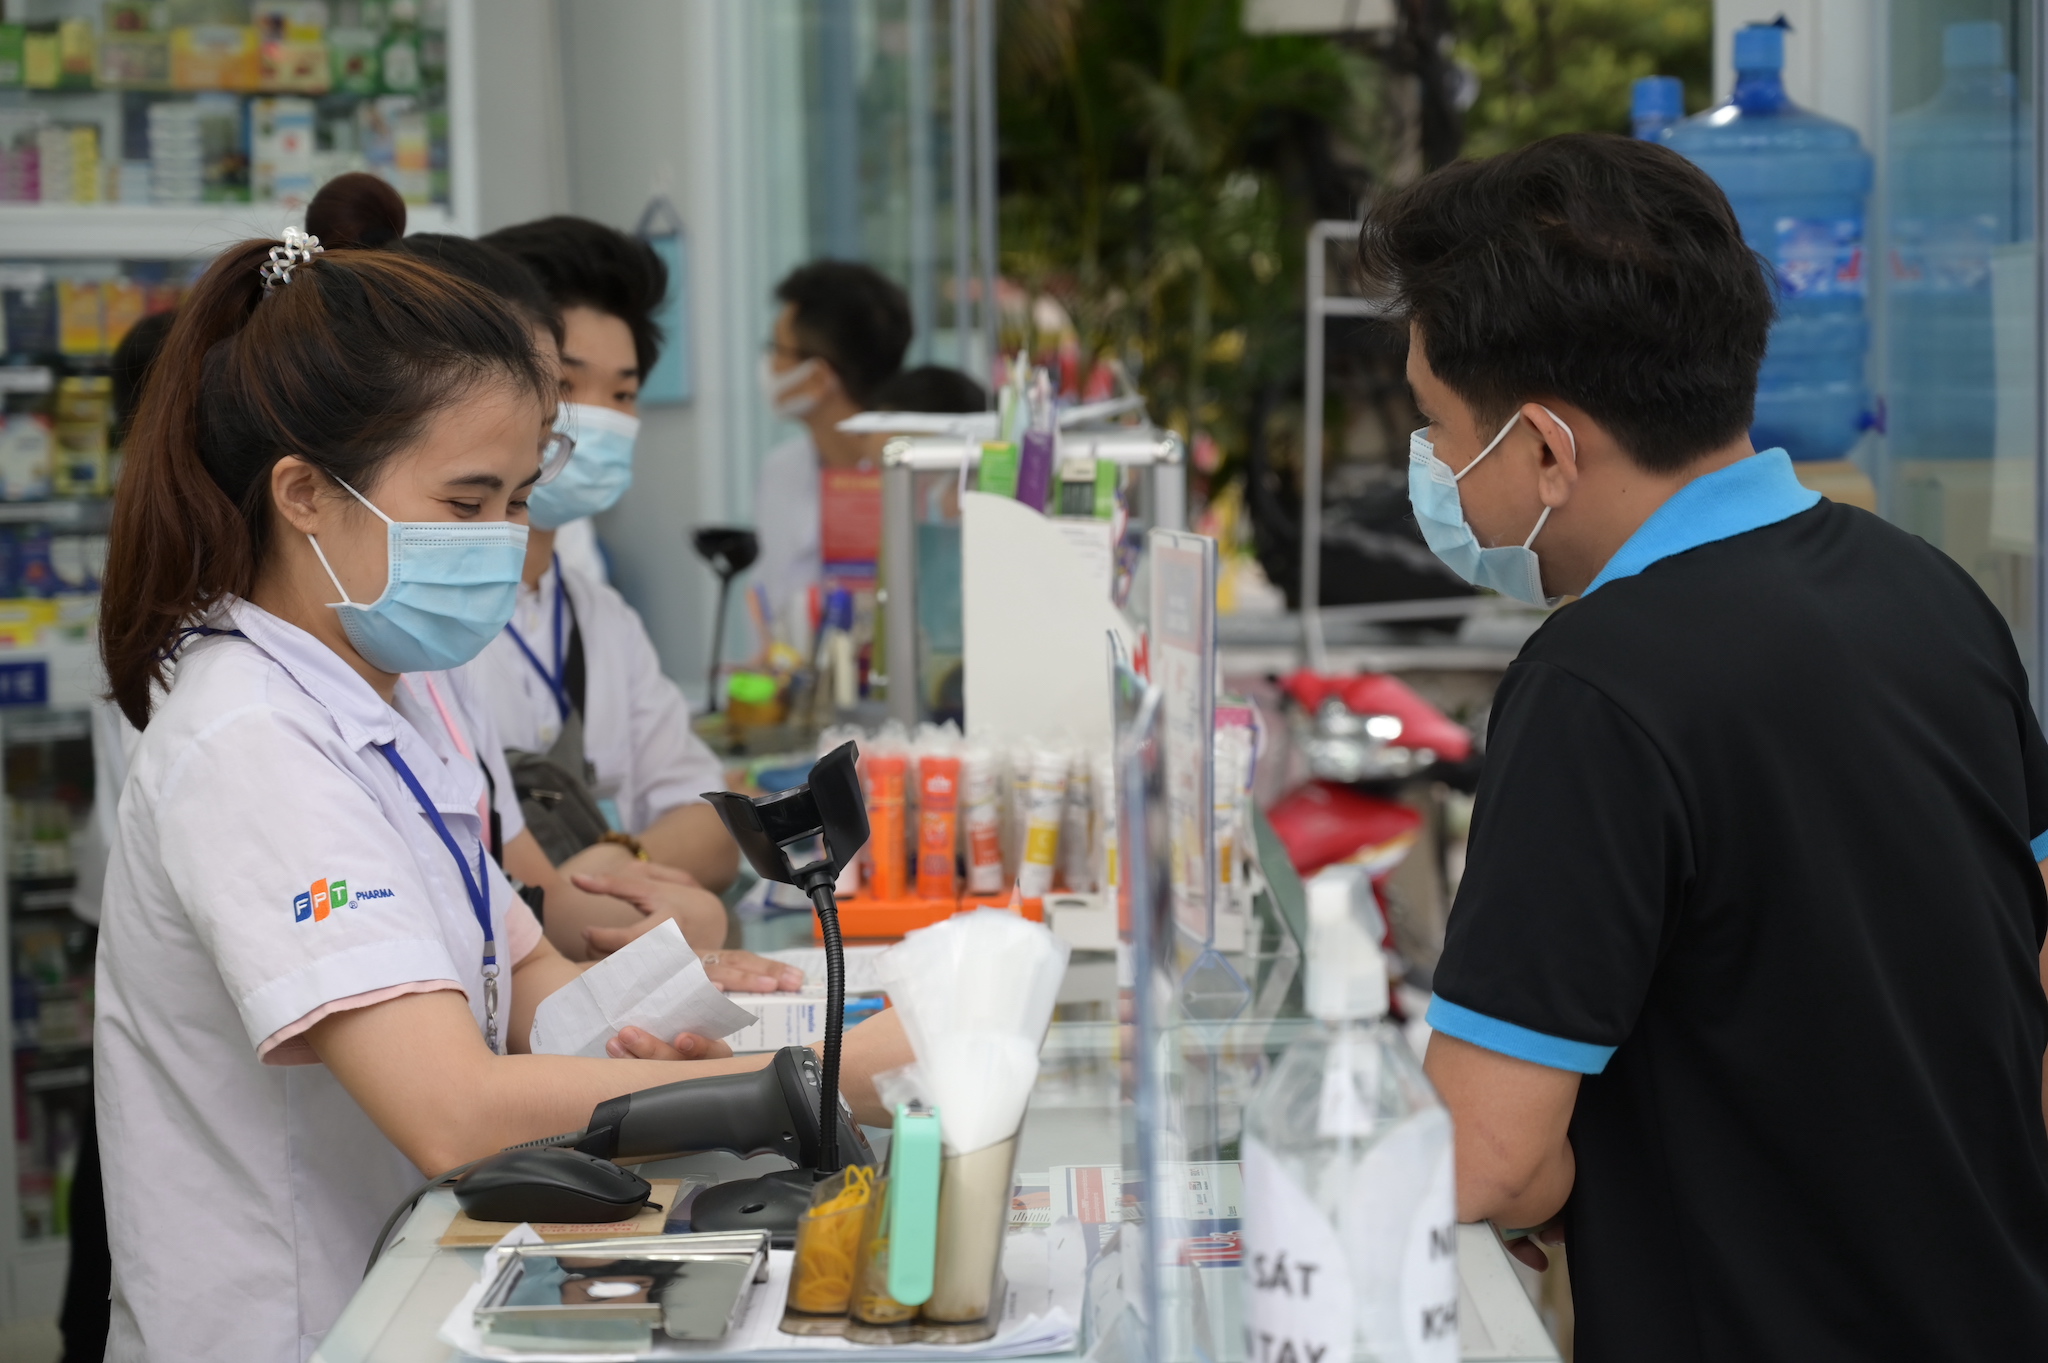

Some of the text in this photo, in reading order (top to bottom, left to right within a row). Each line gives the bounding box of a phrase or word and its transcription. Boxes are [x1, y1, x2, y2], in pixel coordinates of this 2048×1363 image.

[294, 882, 347, 919] FPT
[355, 888, 395, 901] PHARMA
[1253, 1249, 1319, 1297] SÁT
